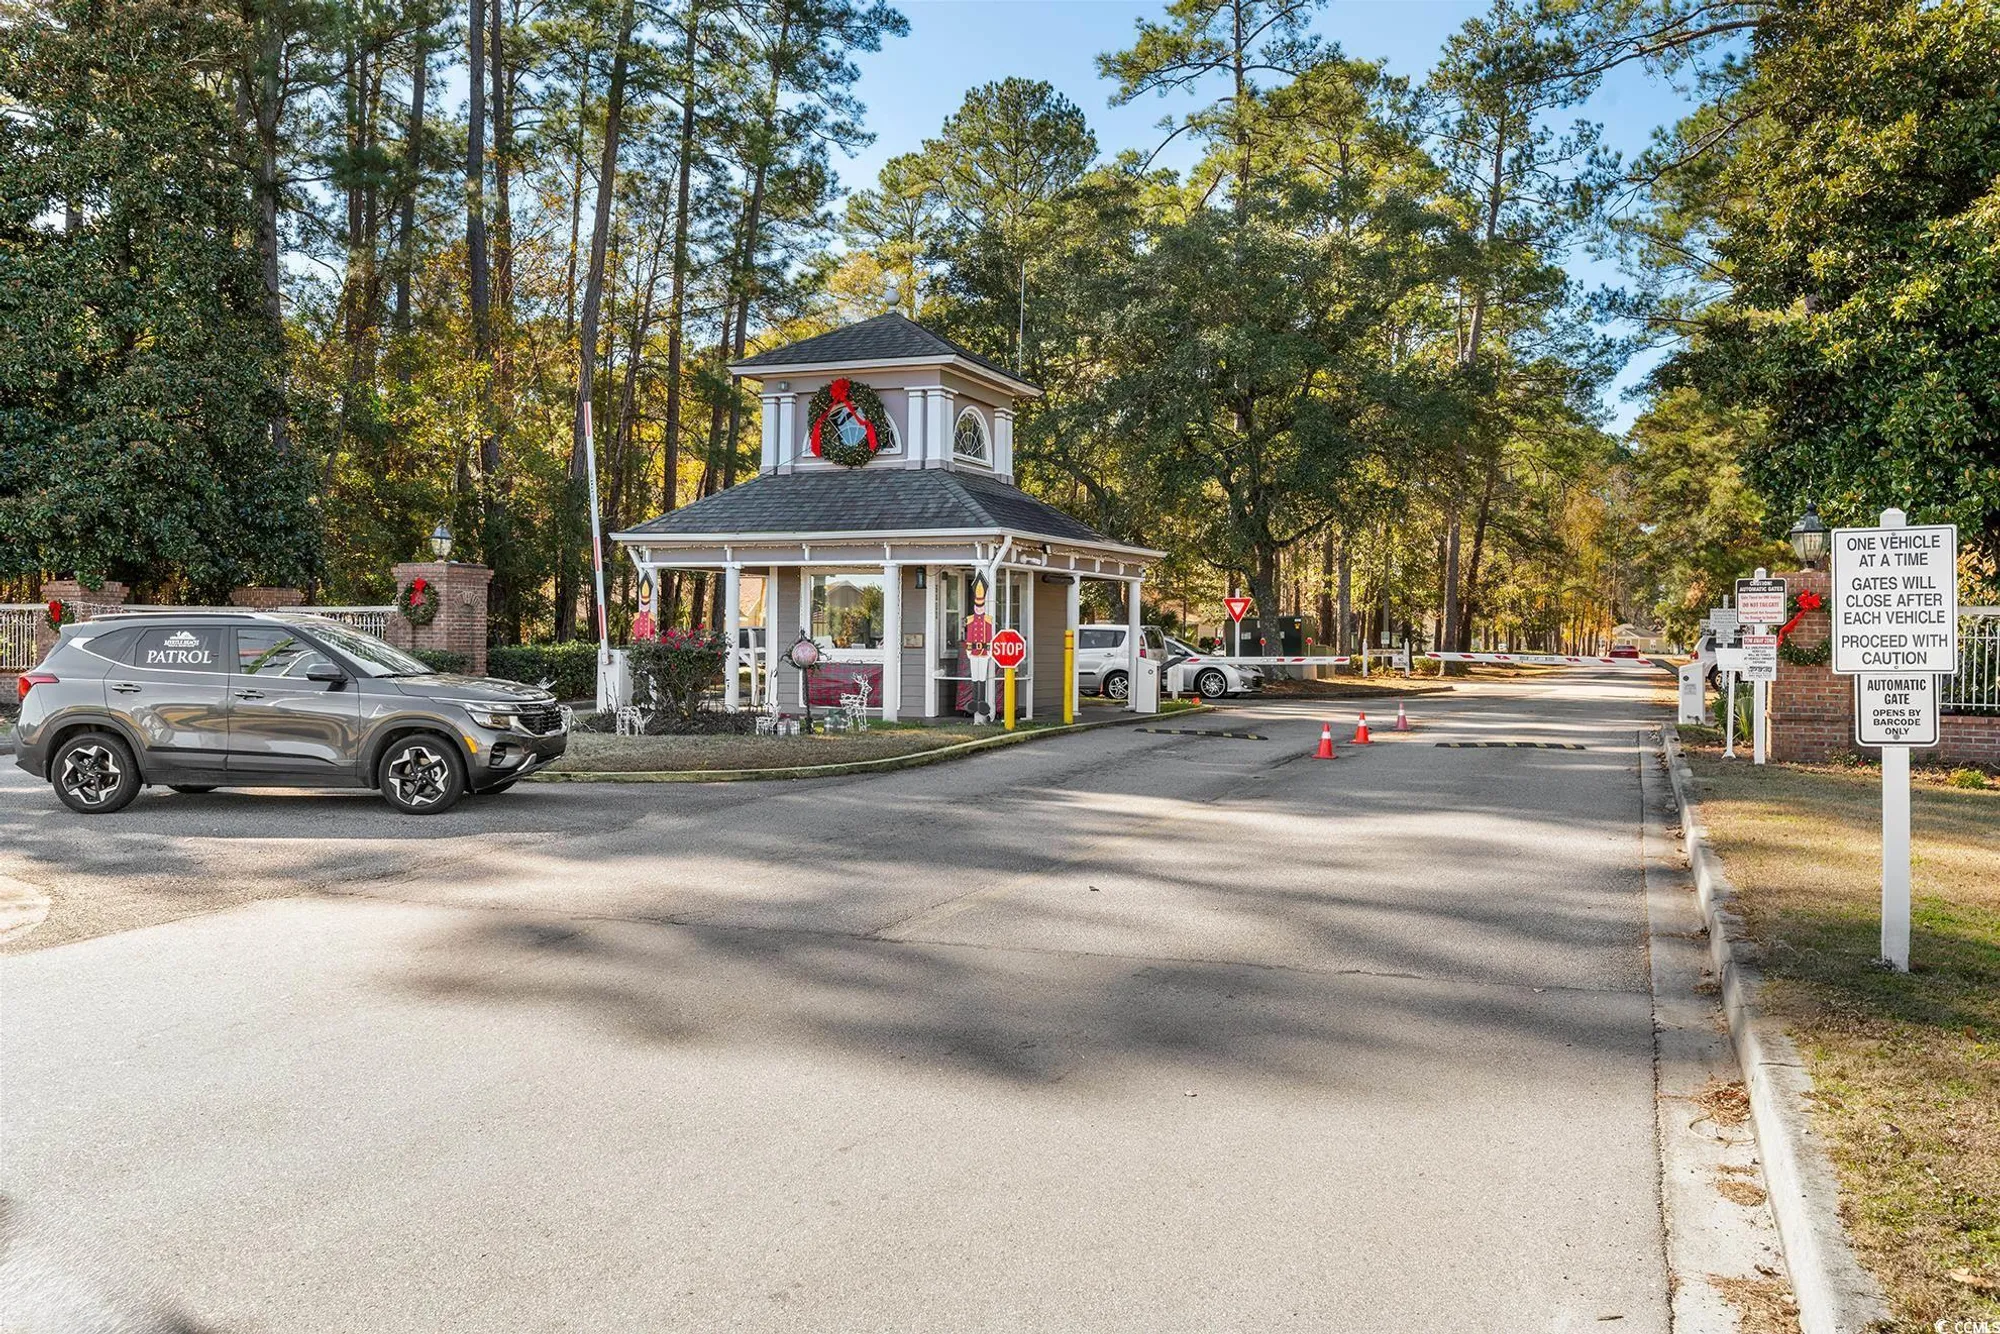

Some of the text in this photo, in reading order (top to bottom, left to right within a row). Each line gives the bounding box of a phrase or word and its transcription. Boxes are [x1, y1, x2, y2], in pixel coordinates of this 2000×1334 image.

[1847, 535, 1940, 551] ONE VEHICLE
[1859, 552, 1928, 568] AT A TIME
[1852, 576, 1936, 590] GATES WILL
[1846, 593, 1942, 608] CLOSE AFTER
[1844, 610, 1946, 625] EACH VEHICLE
[1842, 634, 1948, 648] PROCEED WITH
[993, 642, 1022, 656] STOP
[146, 650, 212, 664] PATROL
[1862, 652, 1927, 665] CAUTION
[1867, 679, 1926, 691] AUTOMATIC
[1884, 693, 1910, 705] GATE
